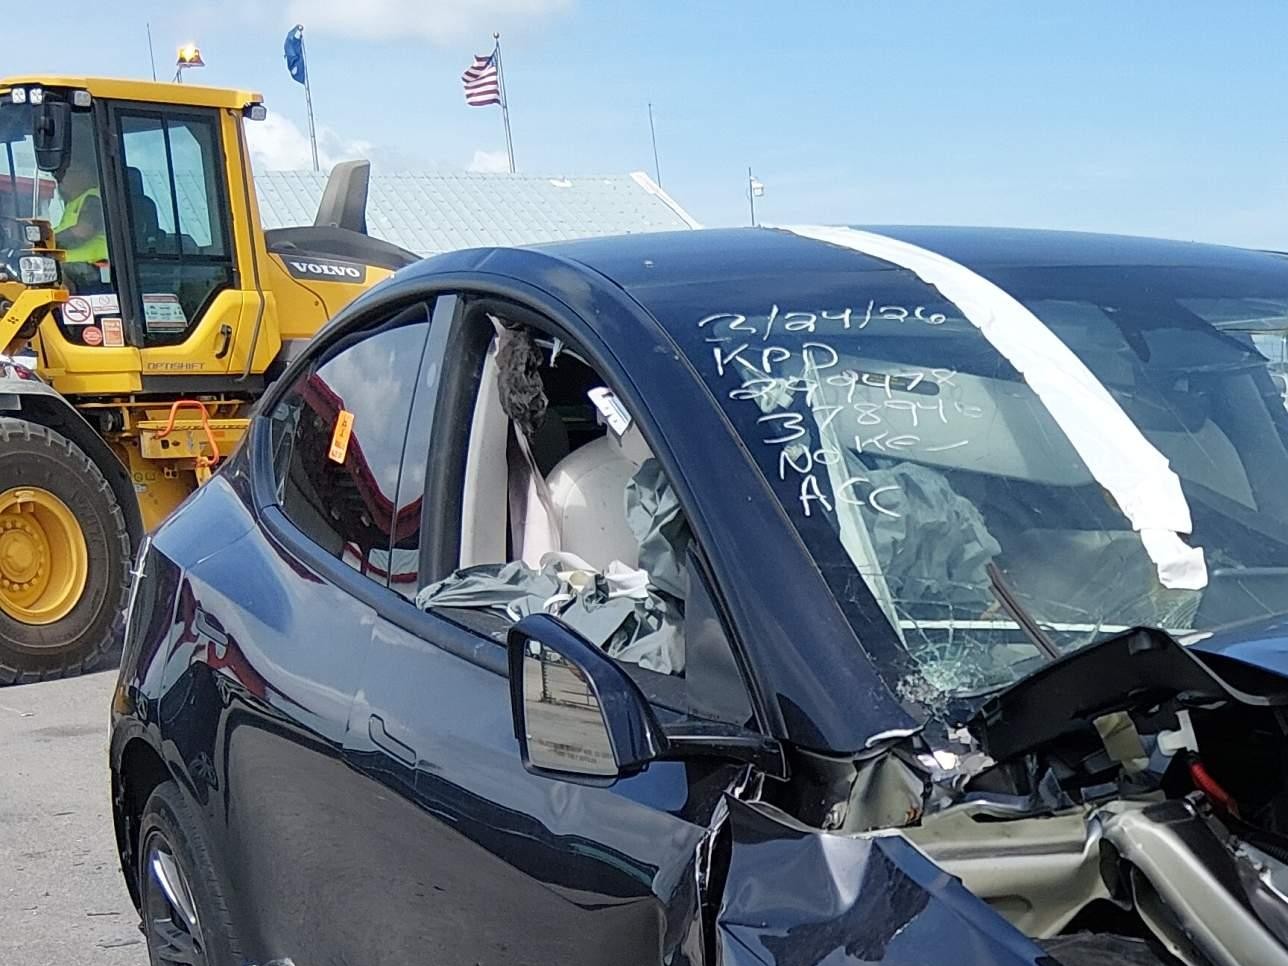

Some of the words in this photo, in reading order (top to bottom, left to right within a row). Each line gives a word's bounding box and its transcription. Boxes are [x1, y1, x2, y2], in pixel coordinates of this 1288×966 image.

[290, 262, 360, 277] VOLVO
[714, 342, 838, 377] KPD
[779, 448, 840, 479] NO
[799, 475, 902, 517] ACC
